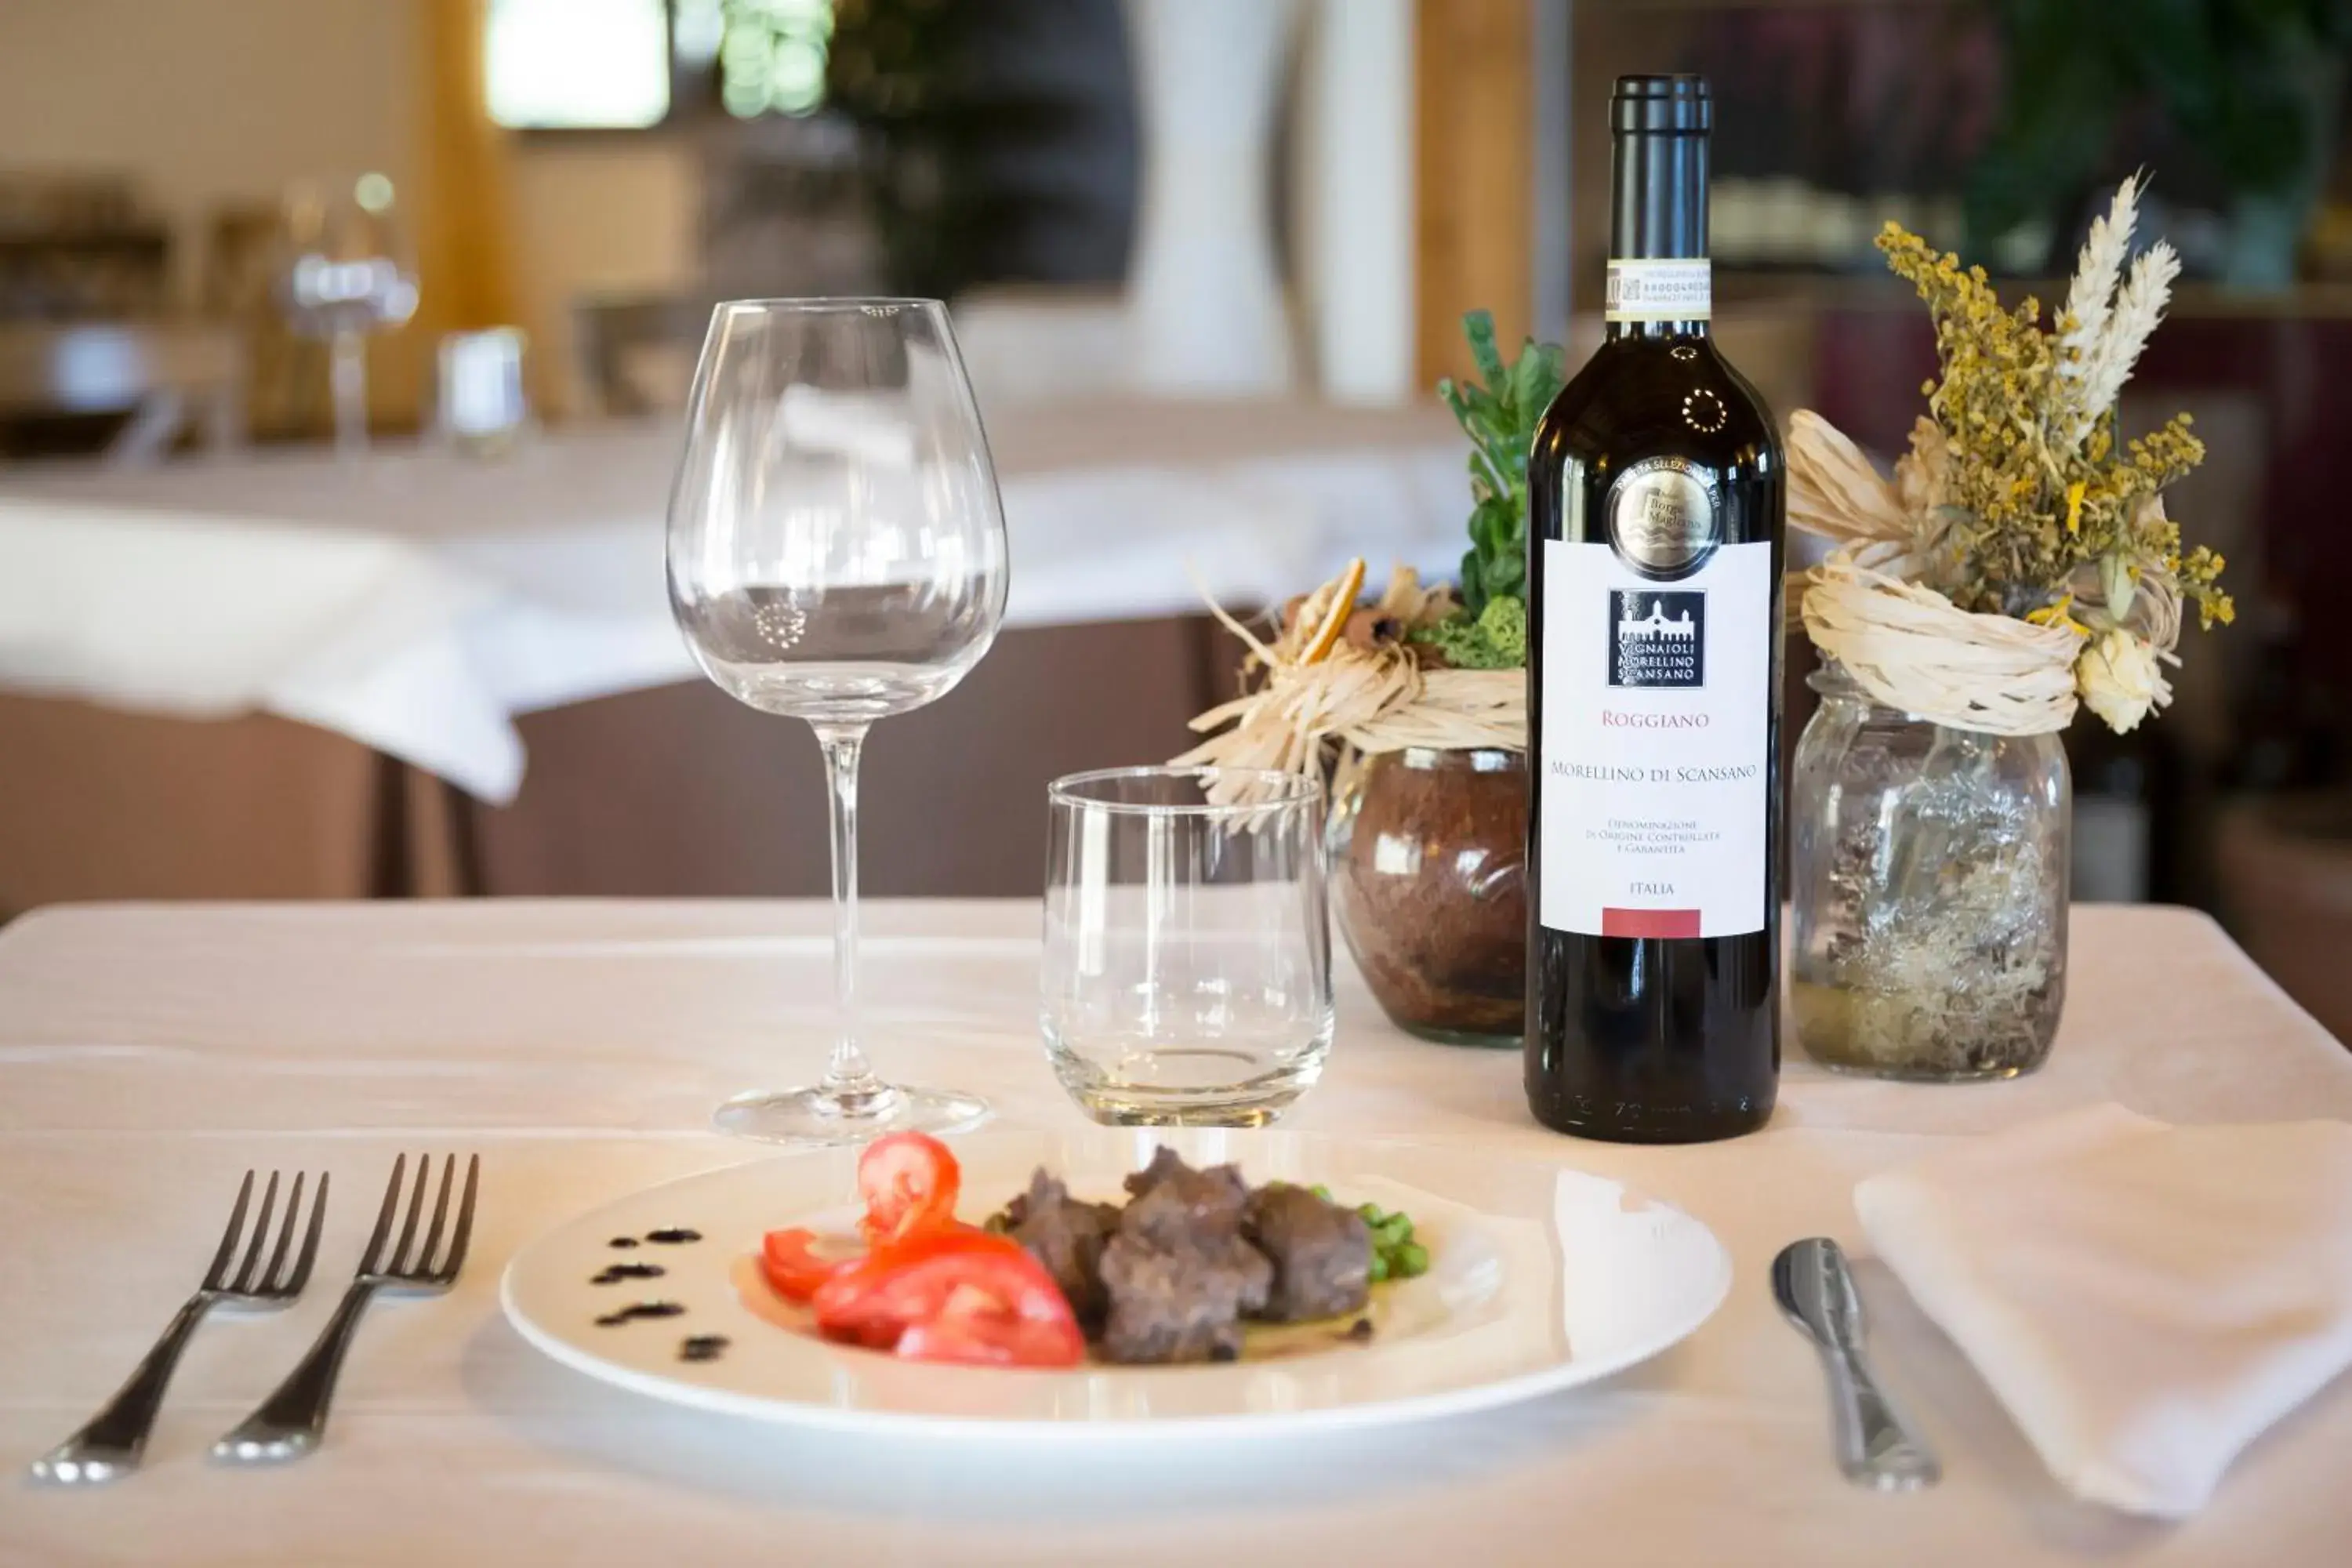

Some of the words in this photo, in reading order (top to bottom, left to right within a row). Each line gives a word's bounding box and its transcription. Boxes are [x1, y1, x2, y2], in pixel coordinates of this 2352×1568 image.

[1618, 643, 1694, 654] VIGNAIOLI
[1618, 656, 1694, 667] MORELLINO
[1618, 669, 1694, 680] SCANSANO
[1602, 709, 1710, 728] ROGGIANO
[1551, 759, 1644, 782] MORELLINO
[1650, 768, 1670, 782] DI
[1676, 764, 1757, 782] SCANSANO
[1629, 881, 1675, 895] ITALIA
